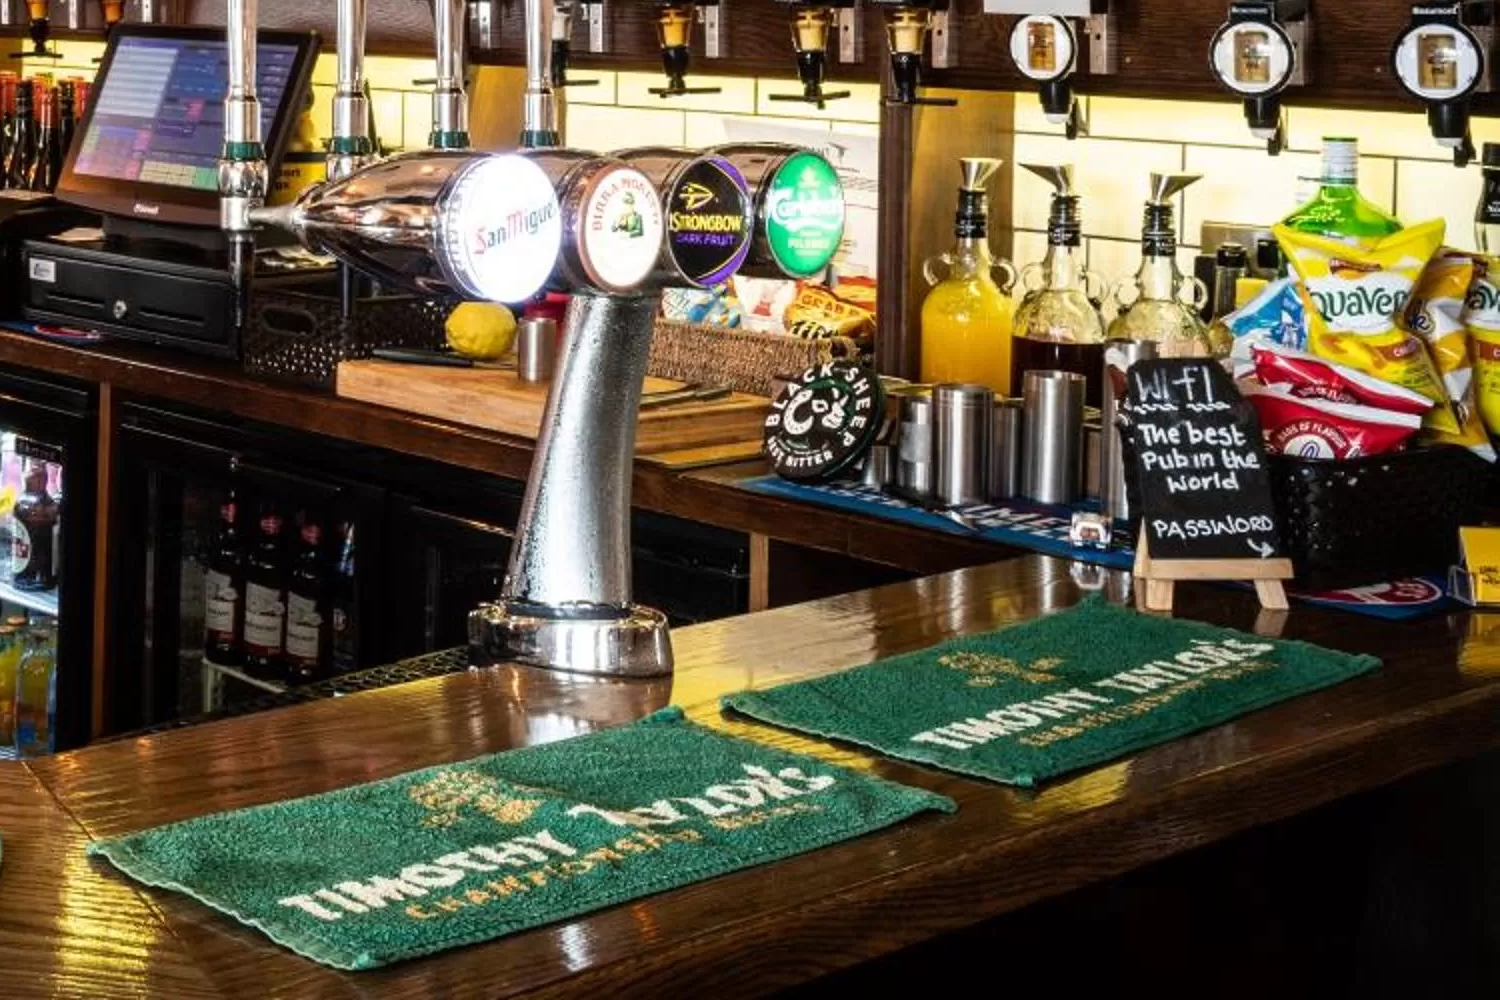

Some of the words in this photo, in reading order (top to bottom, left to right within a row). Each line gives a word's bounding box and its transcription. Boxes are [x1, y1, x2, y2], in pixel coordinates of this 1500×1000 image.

[765, 361, 835, 427] BLACK
[844, 366, 871, 447] SHEEP
[1137, 423, 1181, 447] The
[1185, 419, 1247, 446] best
[1141, 447, 1189, 471] Pub
[1192, 451, 1215, 469] in
[1221, 448, 1260, 470] the
[1152, 514, 1274, 540] PASSWORD
[909, 687, 1114, 751] TIMOTHY
[1097, 638, 1275, 695] TAYLOR'S
[277, 829, 578, 921] TIMOTHY
